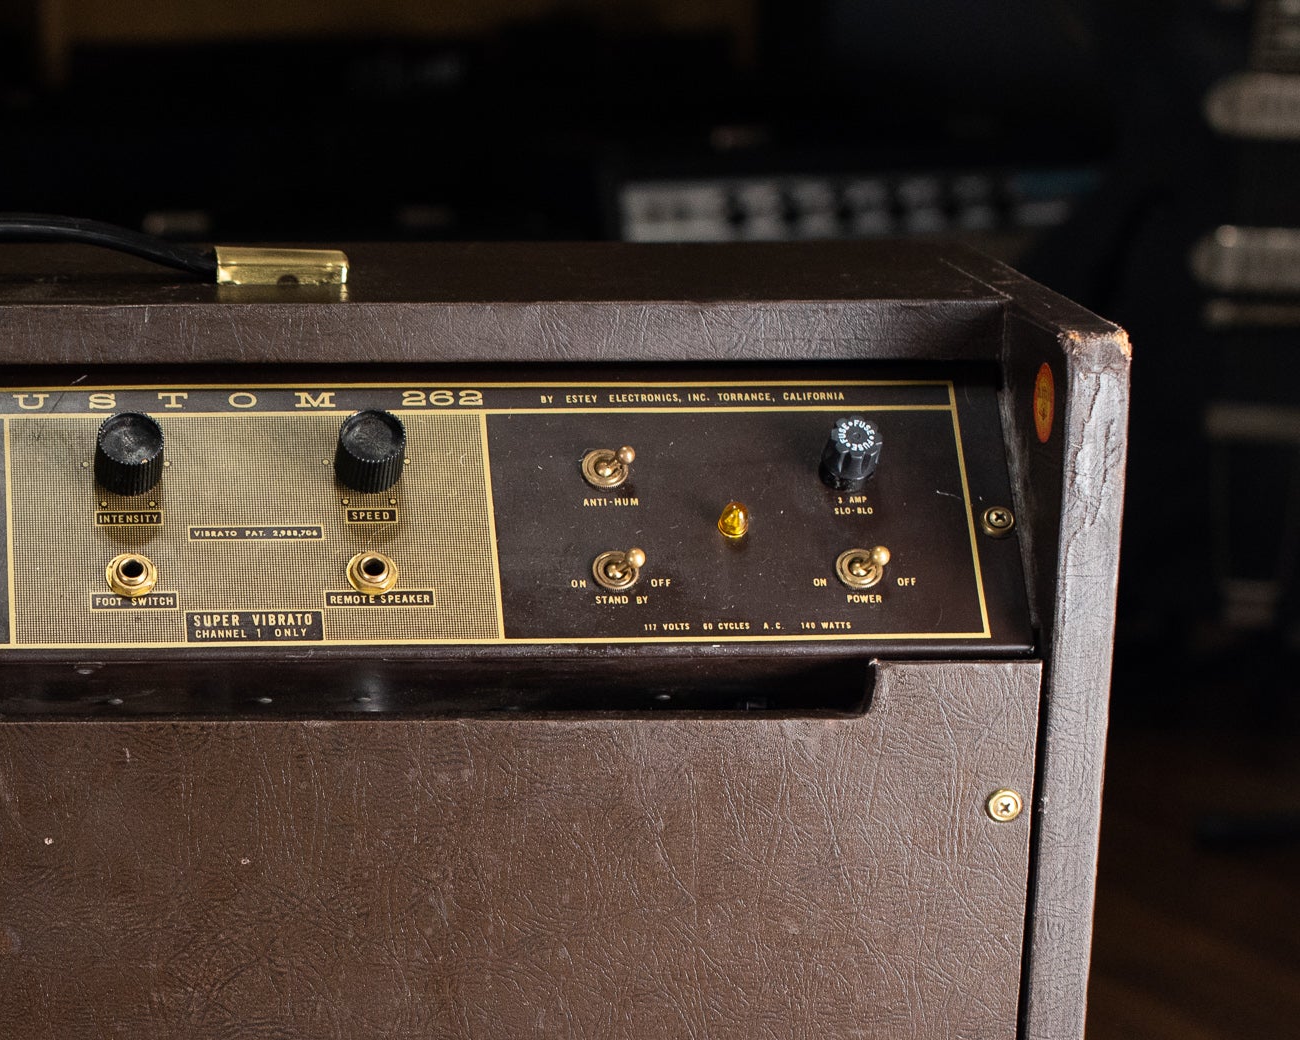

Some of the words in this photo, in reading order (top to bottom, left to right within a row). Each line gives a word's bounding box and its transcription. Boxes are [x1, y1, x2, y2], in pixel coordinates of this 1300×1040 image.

[401, 389, 484, 407] 262
[540, 395, 554, 404] BY
[566, 395, 597, 403] ESTEY
[687, 393, 711, 402] INC.
[783, 392, 845, 401] CALIFORNIA
[853, 419, 875, 436] FUSE
[838, 423, 850, 444] FUSE
[850, 438, 875, 451] FUSE
[583, 497, 639, 507] ANTI-HUM
[849, 496, 867, 504] AMP
[100, 513, 159, 524] INTENSITY
[352, 511, 390, 520] SPEED
[571, 579, 587, 588] ON
[651, 578, 671, 588] OFF
[813, 578, 827, 587] ON
[897, 577, 916, 587] OFF
[96, 597, 123, 606] FOOT
[131, 597, 174, 606] SWITCH
[330, 595, 375, 604] REMOTE
[380, 594, 431, 604] SPEAKER
[595, 595, 629, 605] STAND
[635, 595, 648, 604] BY
[847, 594, 882, 603] POWER
[193, 613, 240, 626] SUPER
[252, 613, 313, 625] VIBRATO
[195, 629, 247, 638] CHANNEL
[257, 629, 262, 638] 1
[275, 628, 307, 638] ONLY
